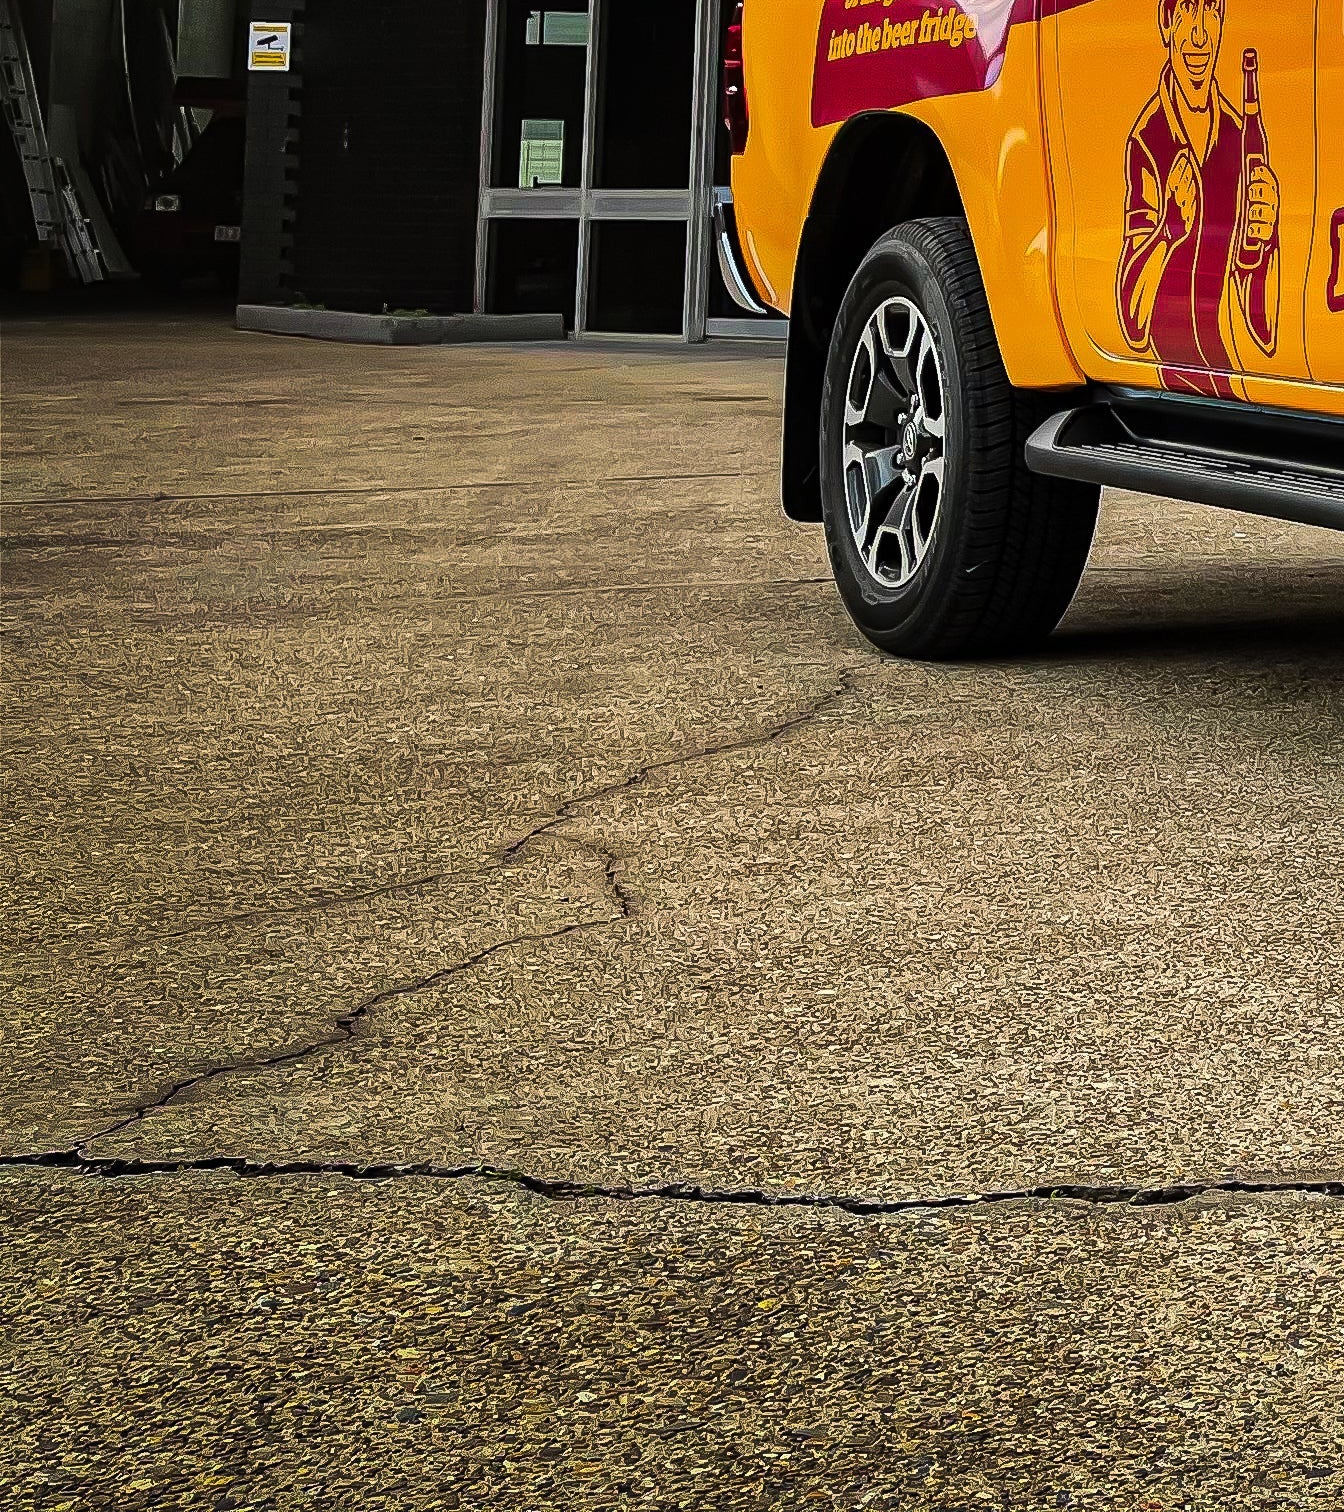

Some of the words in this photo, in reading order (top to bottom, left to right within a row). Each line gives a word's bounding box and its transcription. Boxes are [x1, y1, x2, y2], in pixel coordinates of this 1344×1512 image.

[827, 29, 855, 62] into
[856, 22, 881, 55] the
[882, 17, 919, 50] beer
[918, 7, 979, 48] fridge
